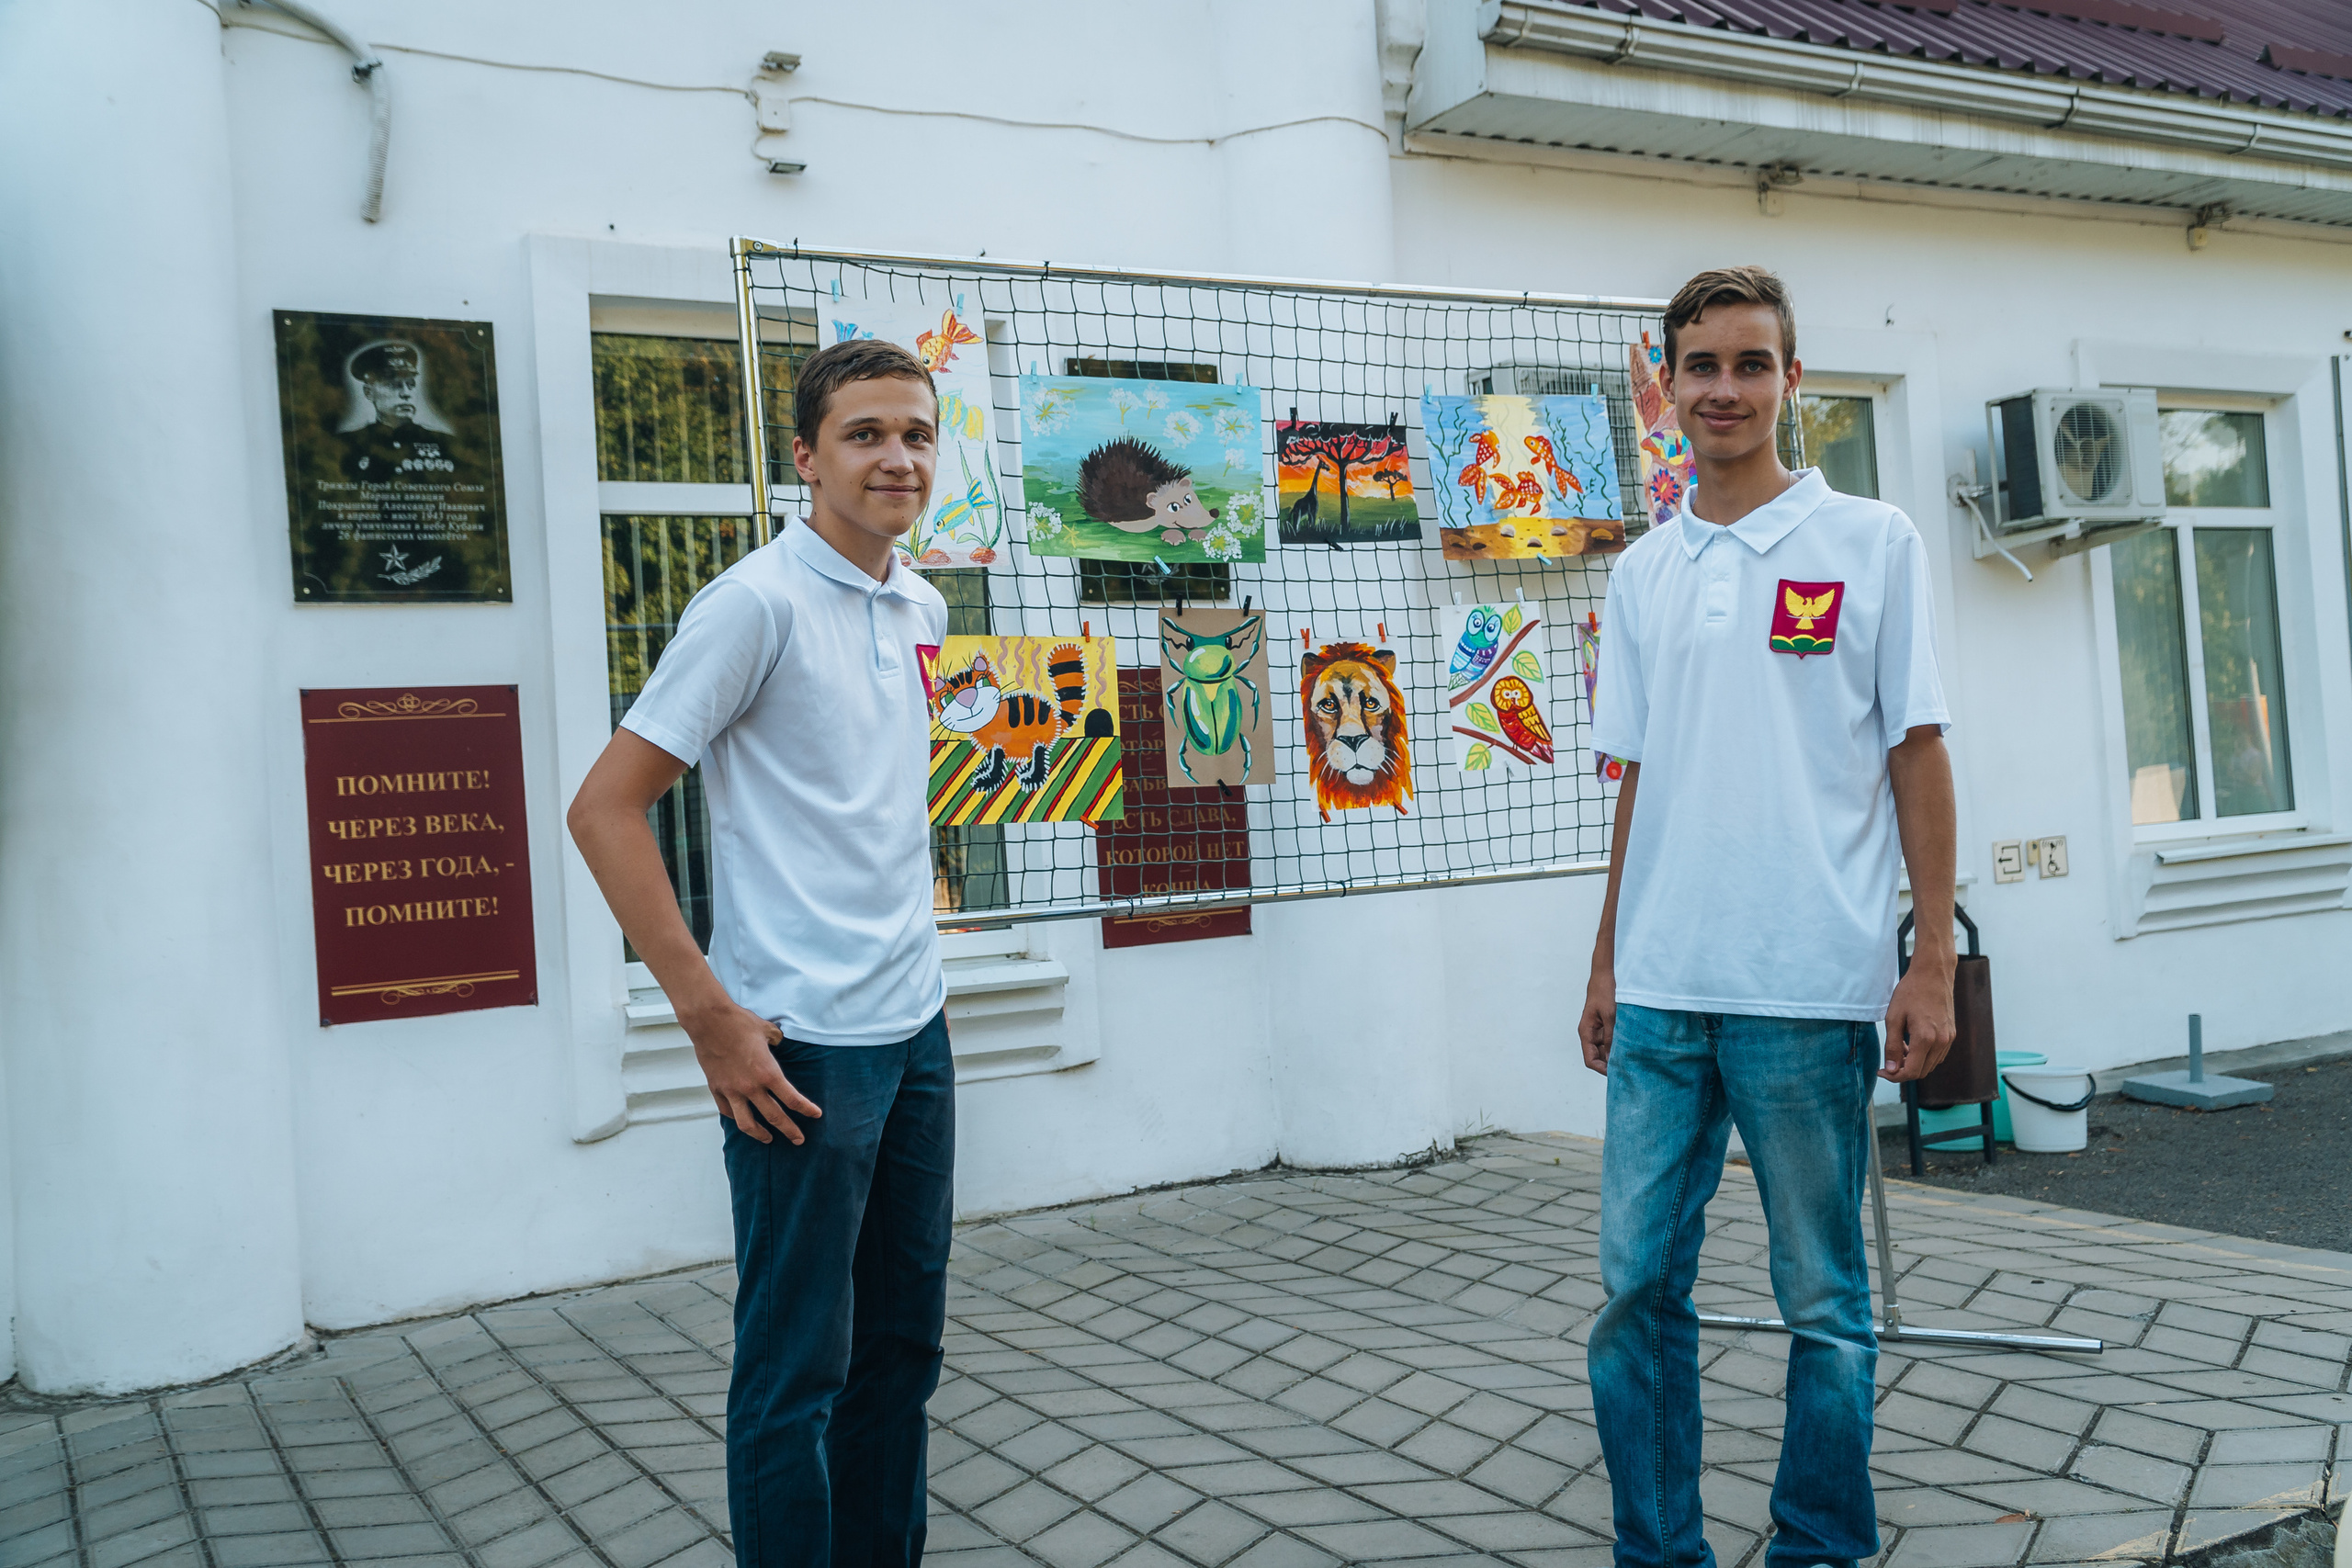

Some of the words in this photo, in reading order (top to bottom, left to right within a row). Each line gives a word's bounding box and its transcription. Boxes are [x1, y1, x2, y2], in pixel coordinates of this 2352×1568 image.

[317, 479, 357, 491] Трижды
[361, 479, 391, 491] Герой
[394, 480, 451, 491] Советского
[453, 481, 484, 492] Союза
[360, 491, 401, 502] Маршал
[404, 492, 445, 502] авиации
[318, 499, 379, 512] Покрышкин
[382, 501, 435, 512] Александр
[438, 502, 485, 512] Иванович
[347, 512, 381, 522] апреле
[422, 511, 444, 521] 1943
[446, 513, 468, 521] года
[322, 522, 354, 530] лично
[356, 522, 412, 532] уничтожил
[423, 521, 446, 530] небе
[448, 521, 484, 532] Кубани
[353, 529, 414, 542] фашистских
[1119, 704, 1153, 719] СТЬ
[336, 770, 490, 796] ПОМНИТЕ!
[1114, 811, 1161, 829] ЕСТЬ
[1167, 807, 1237, 827] СЛАВА,
[327, 816, 417, 840] ЧЕРЕЗ
[424, 813, 504, 835] ВЕКА,
[1106, 840, 1201, 866] КОТОРОЙ
[1206, 840, 1245, 859] НЕТ
[322, 859, 413, 884] ЧЕРЕЗ
[420, 855, 499, 879] ГОДА,
[345, 897, 499, 927] ПОМНИТЕ!
